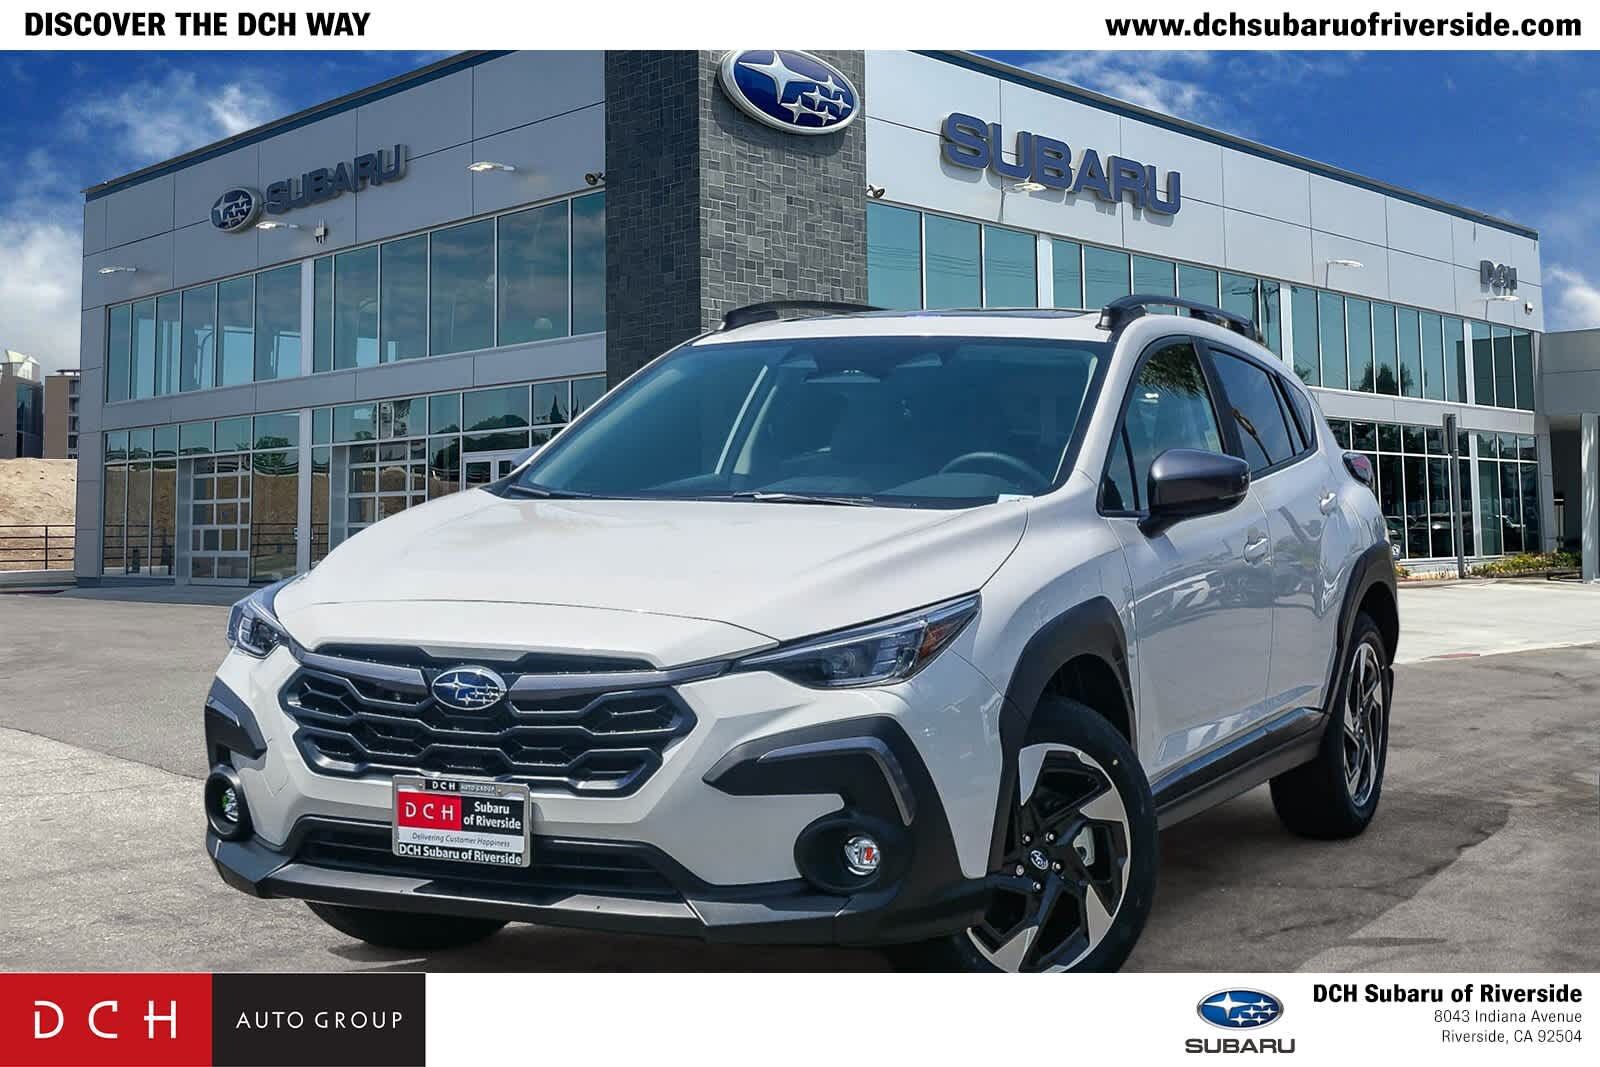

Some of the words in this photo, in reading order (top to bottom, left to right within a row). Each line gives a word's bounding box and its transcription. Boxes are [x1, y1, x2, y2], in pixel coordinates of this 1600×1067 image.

[940, 112, 1181, 215] SUBARU
[266, 143, 407, 215] SUBARU
[432, 780, 456, 790] DCH
[405, 802, 454, 821] DCH
[474, 801, 510, 814] Subaru
[463, 814, 475, 825] of
[476, 816, 521, 830] Riverside
[412, 832, 445, 844] Delivering
[445, 834, 476, 845] Customer
[477, 837, 510, 849] Happiness
[399, 844, 421, 856] DCH
[423, 845, 459, 859] Subaru
[461, 848, 473, 861] of
[474, 851, 522, 865] Riverside
